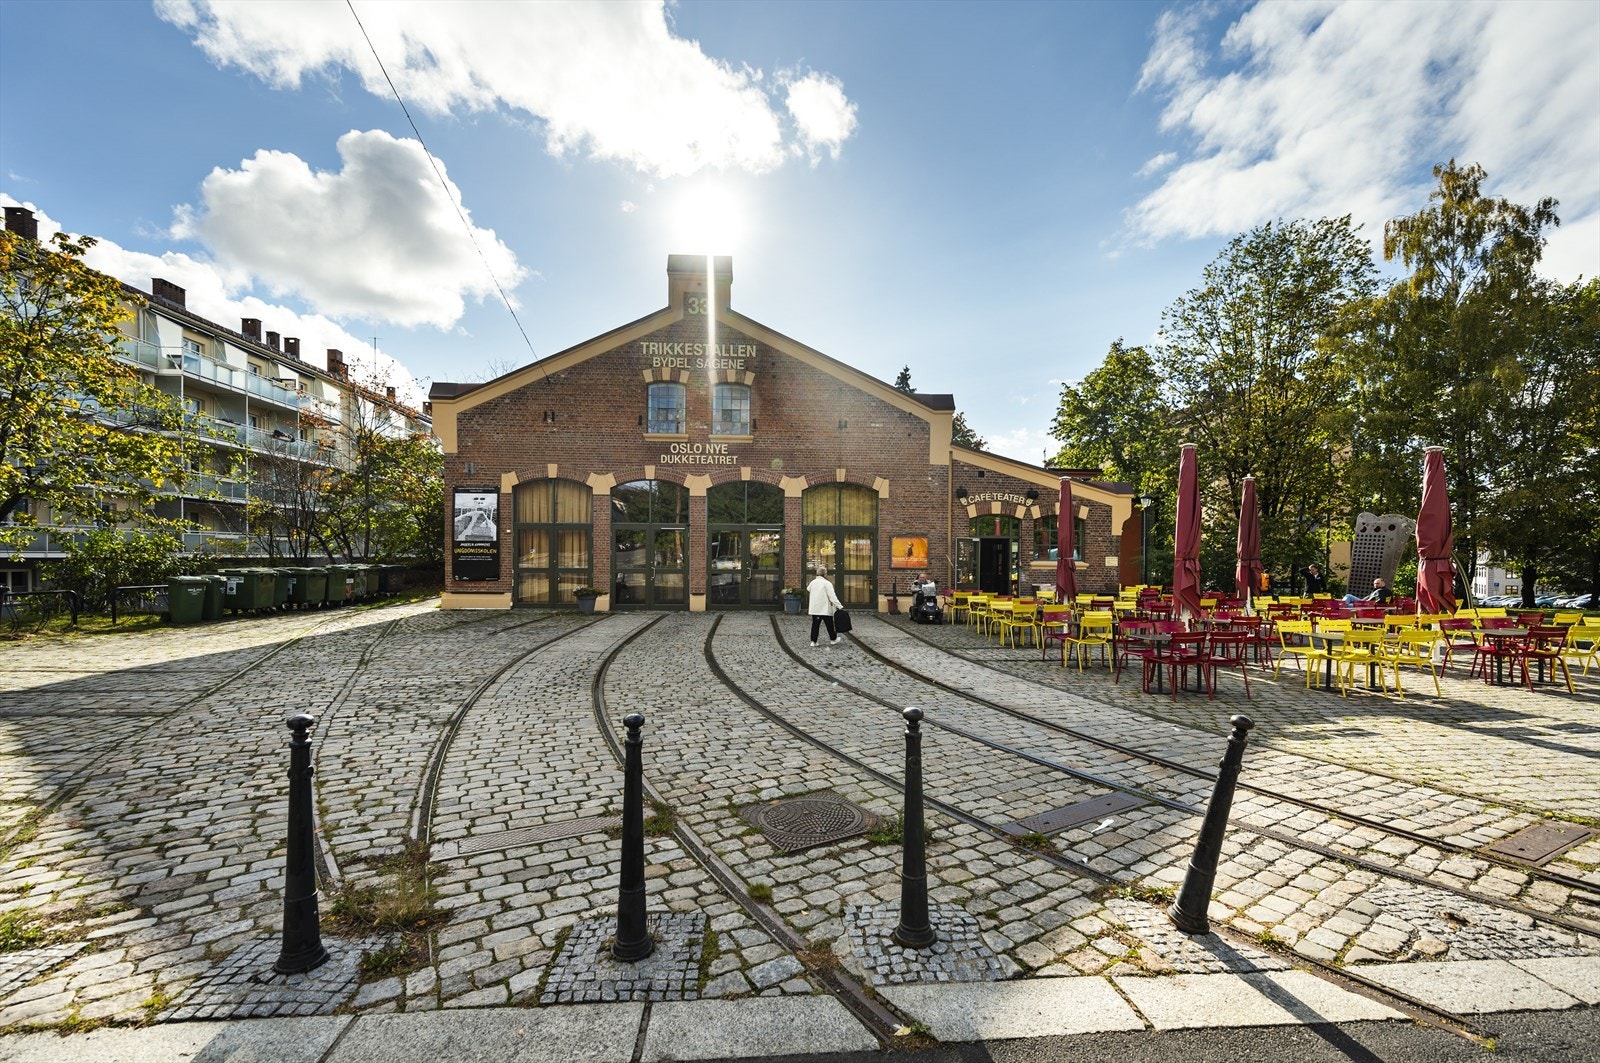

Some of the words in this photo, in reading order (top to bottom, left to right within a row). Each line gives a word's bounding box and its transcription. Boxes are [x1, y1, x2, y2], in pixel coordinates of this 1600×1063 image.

[640, 342, 757, 357] TRIKKESTALLEN
[653, 357, 691, 368] BYDEL
[696, 358, 745, 369] SAGENE
[670, 443, 702, 454] OSLO
[706, 443, 729, 454] NYE
[660, 454, 738, 465] DUKKETEATRET
